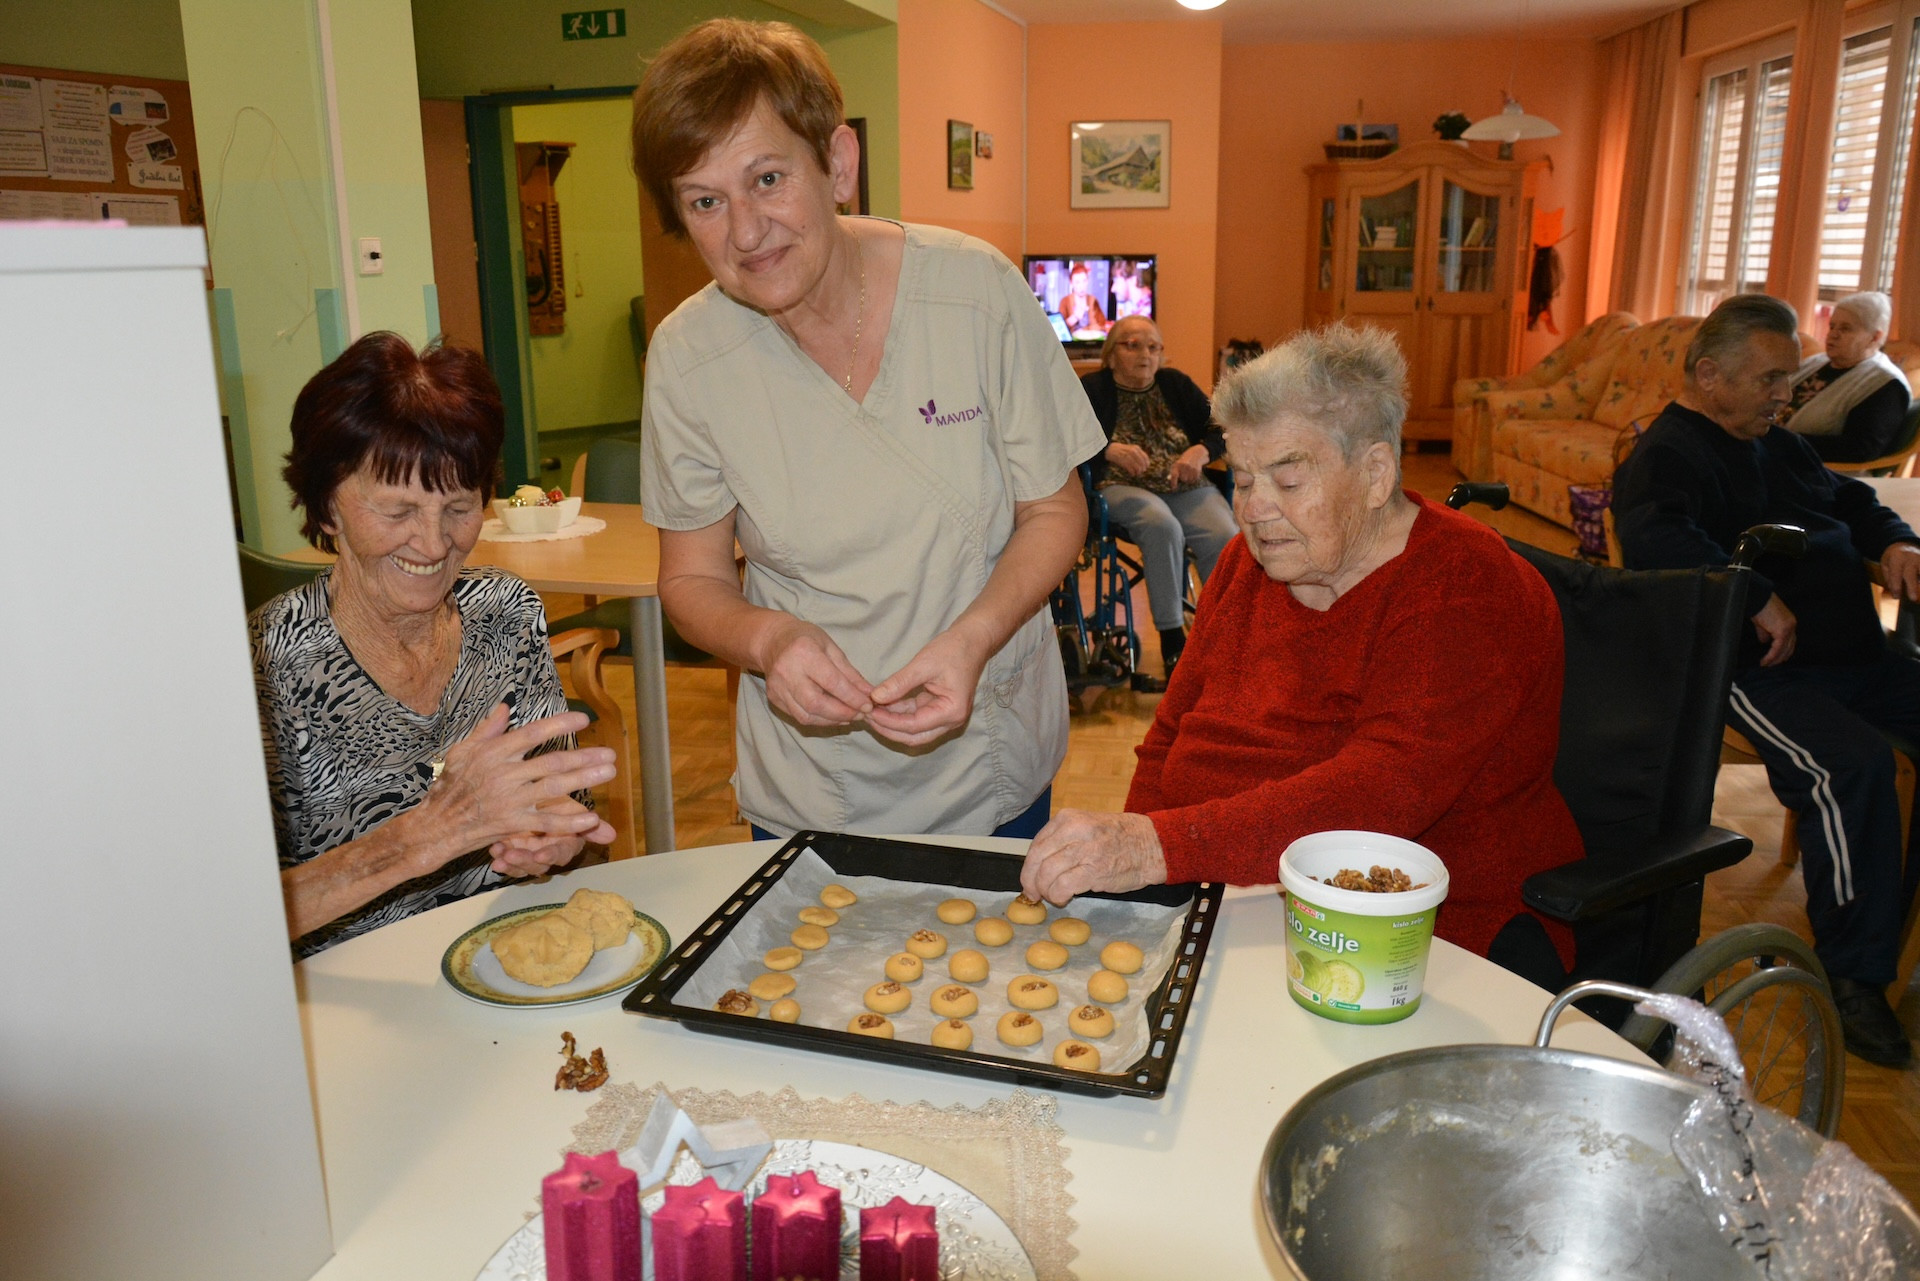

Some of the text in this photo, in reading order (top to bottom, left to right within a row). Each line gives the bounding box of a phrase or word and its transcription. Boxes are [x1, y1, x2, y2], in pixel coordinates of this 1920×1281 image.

[935, 405, 983, 427] MAVIDA
[1392, 920, 1409, 929] kislo
[1308, 927, 1360, 954] zelje
